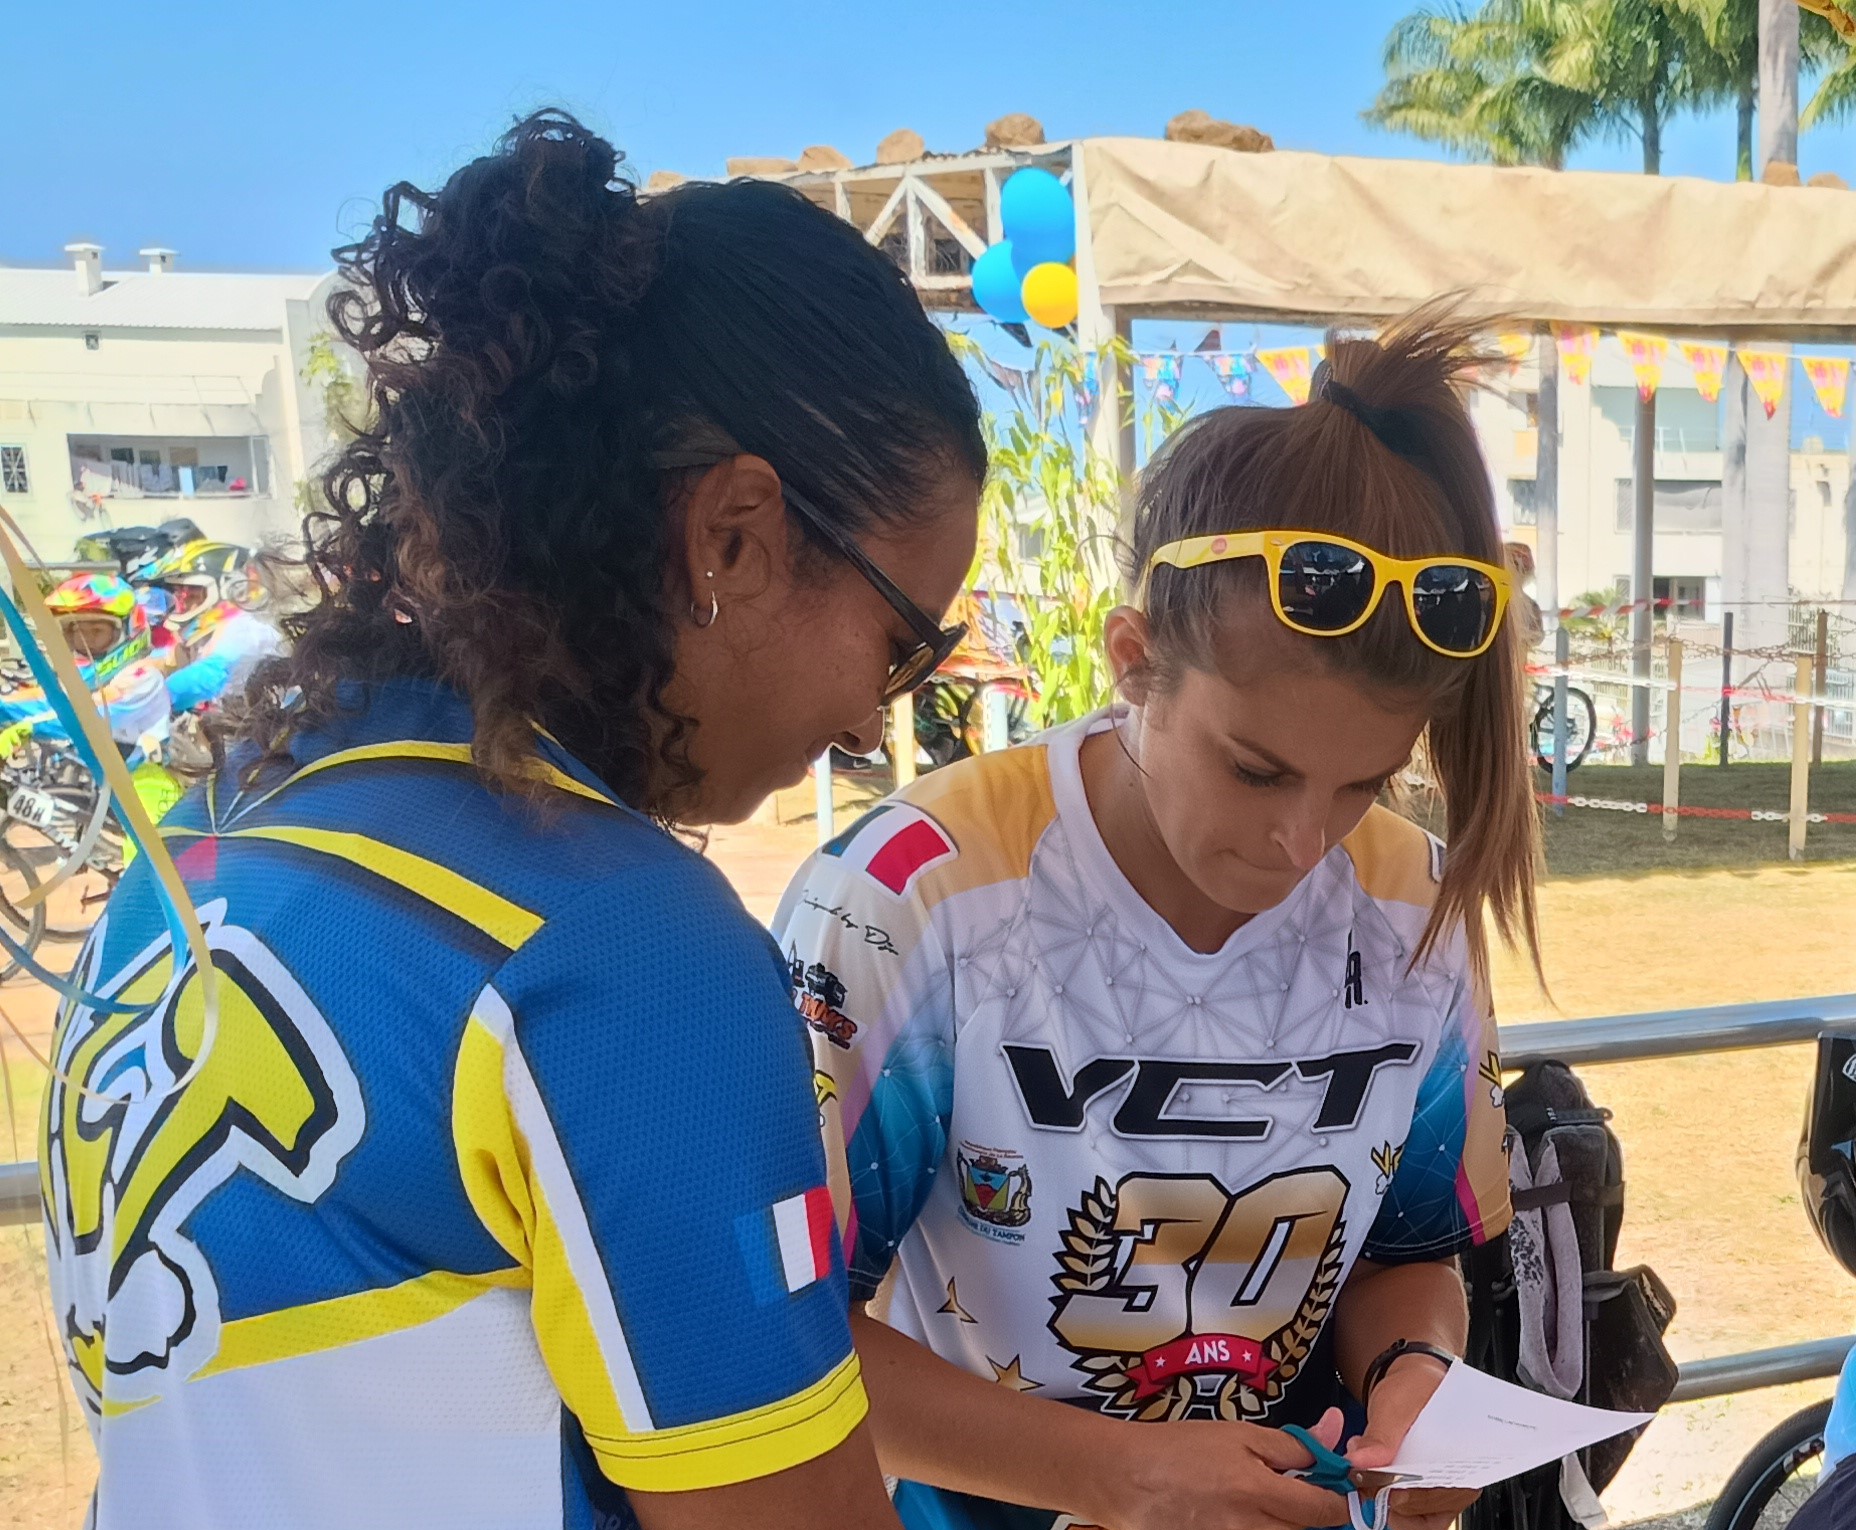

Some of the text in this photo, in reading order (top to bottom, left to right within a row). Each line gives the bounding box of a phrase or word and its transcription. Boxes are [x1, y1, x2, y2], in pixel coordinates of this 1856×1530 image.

[1003, 1042, 1422, 1138] VCT
[1046, 1163, 1352, 1357] 30
[1184, 1339, 1232, 1366] ANS
